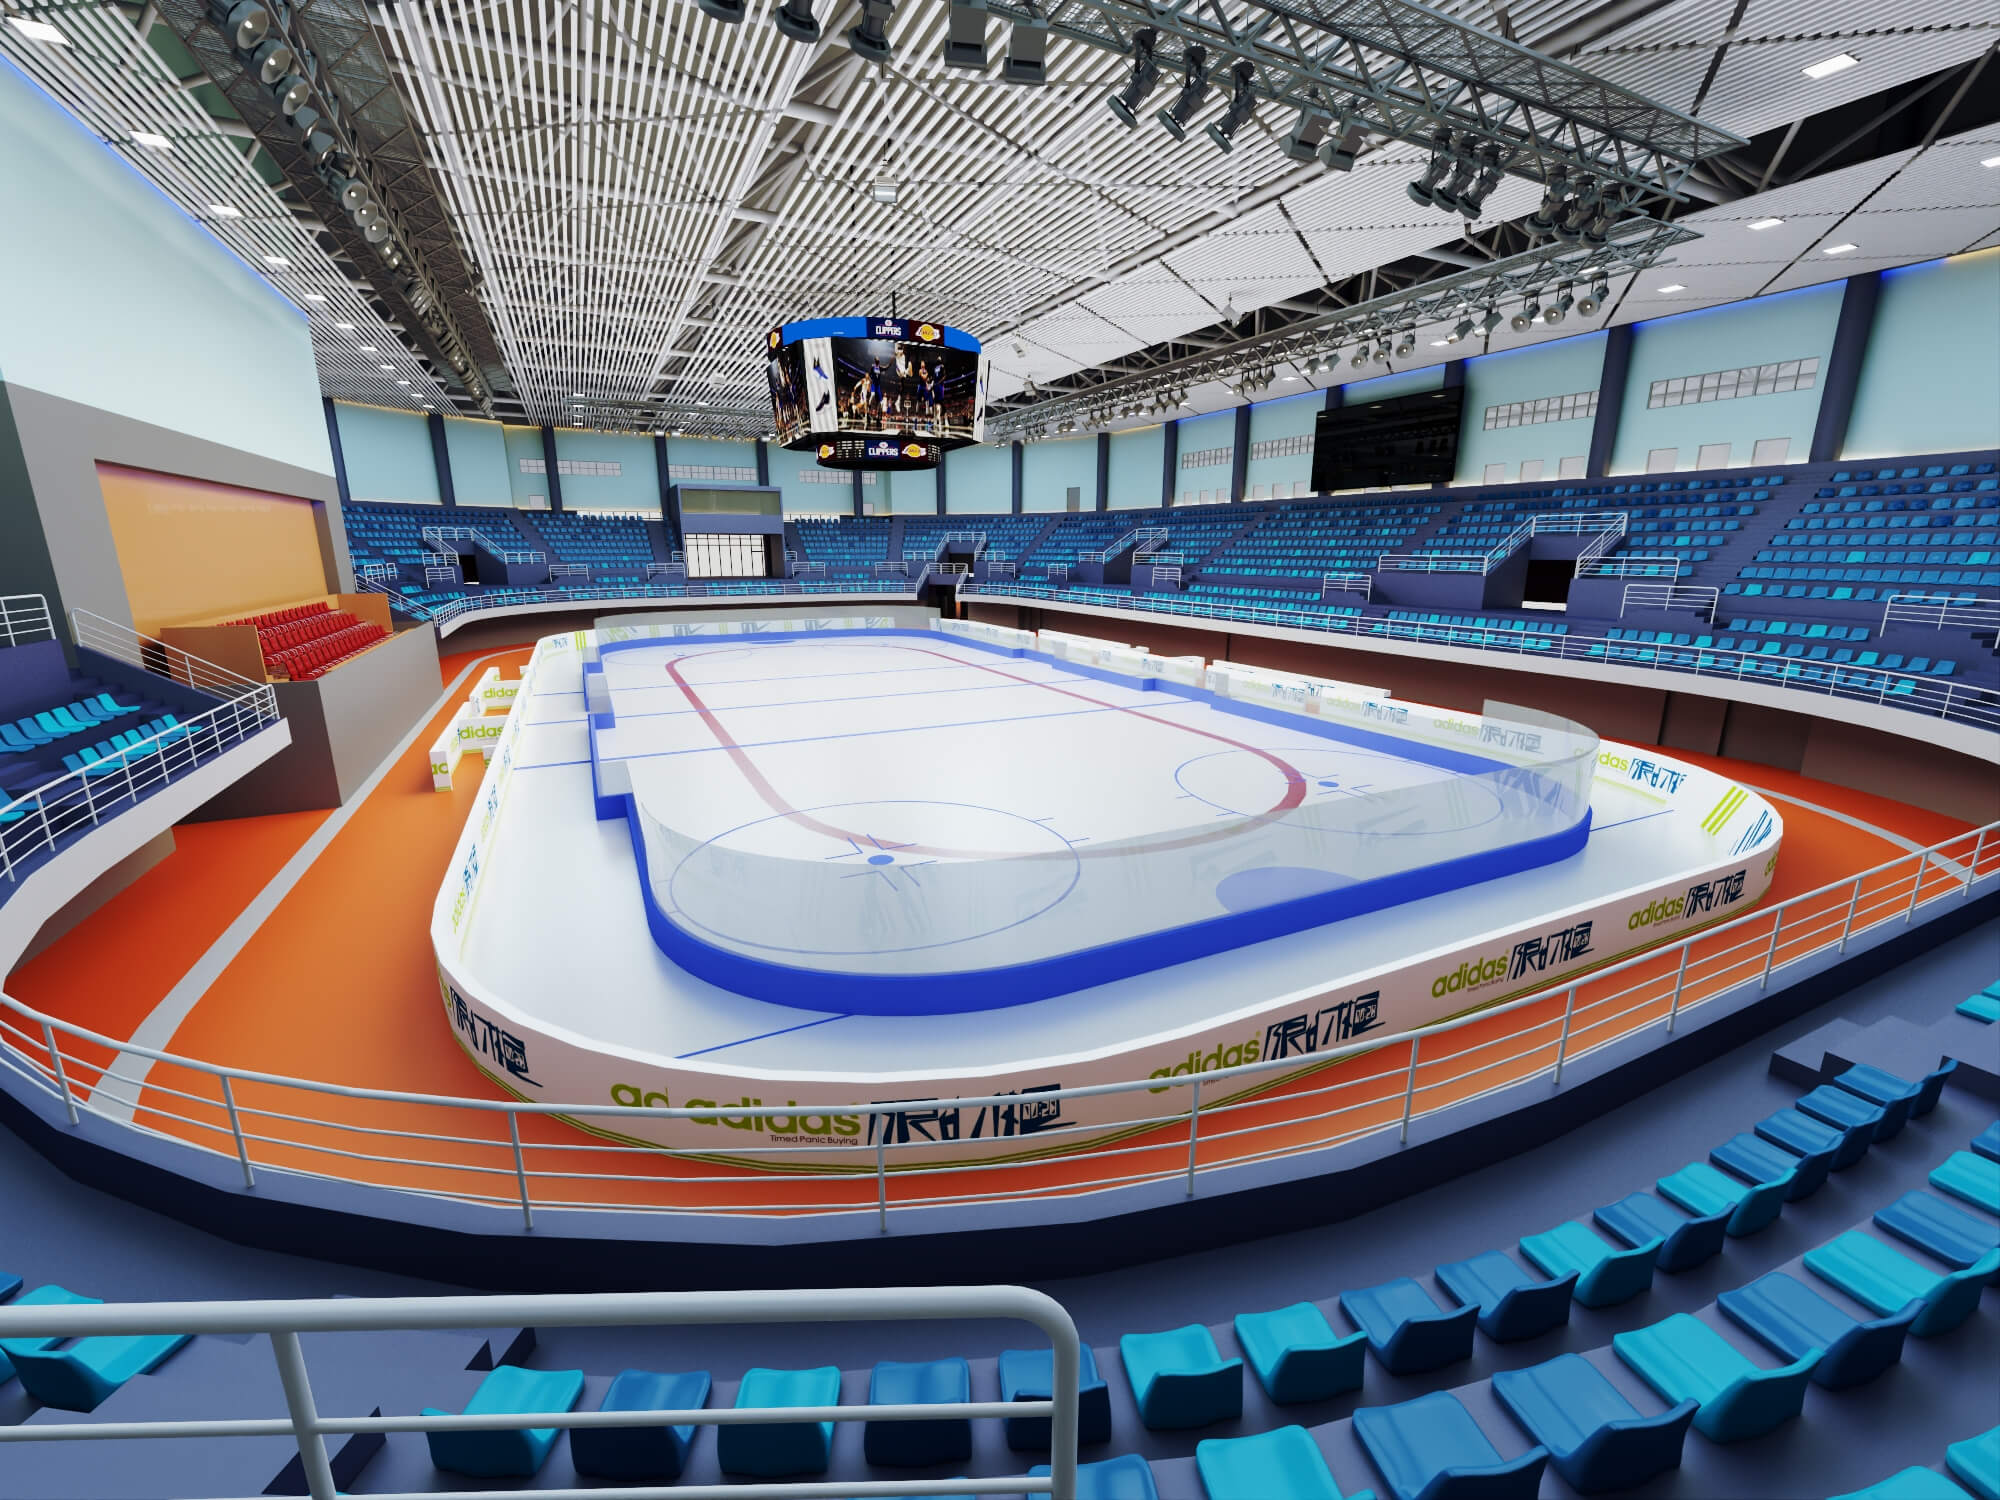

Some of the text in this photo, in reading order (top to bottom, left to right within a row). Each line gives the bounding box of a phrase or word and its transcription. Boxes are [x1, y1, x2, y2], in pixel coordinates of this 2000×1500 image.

[875, 325, 902, 336] CLIPPERS
[868, 447, 899, 456] CLIPPERS
[1433, 718, 1479, 737] adidas
[1628, 896, 1685, 931] adidas
[1432, 955, 1508, 998] adidas
[1149, 1039, 1260, 1094] adidas
[684, 1096, 861, 1137] adidas
[770, 1134, 858, 1146] Timed Panic Buying
